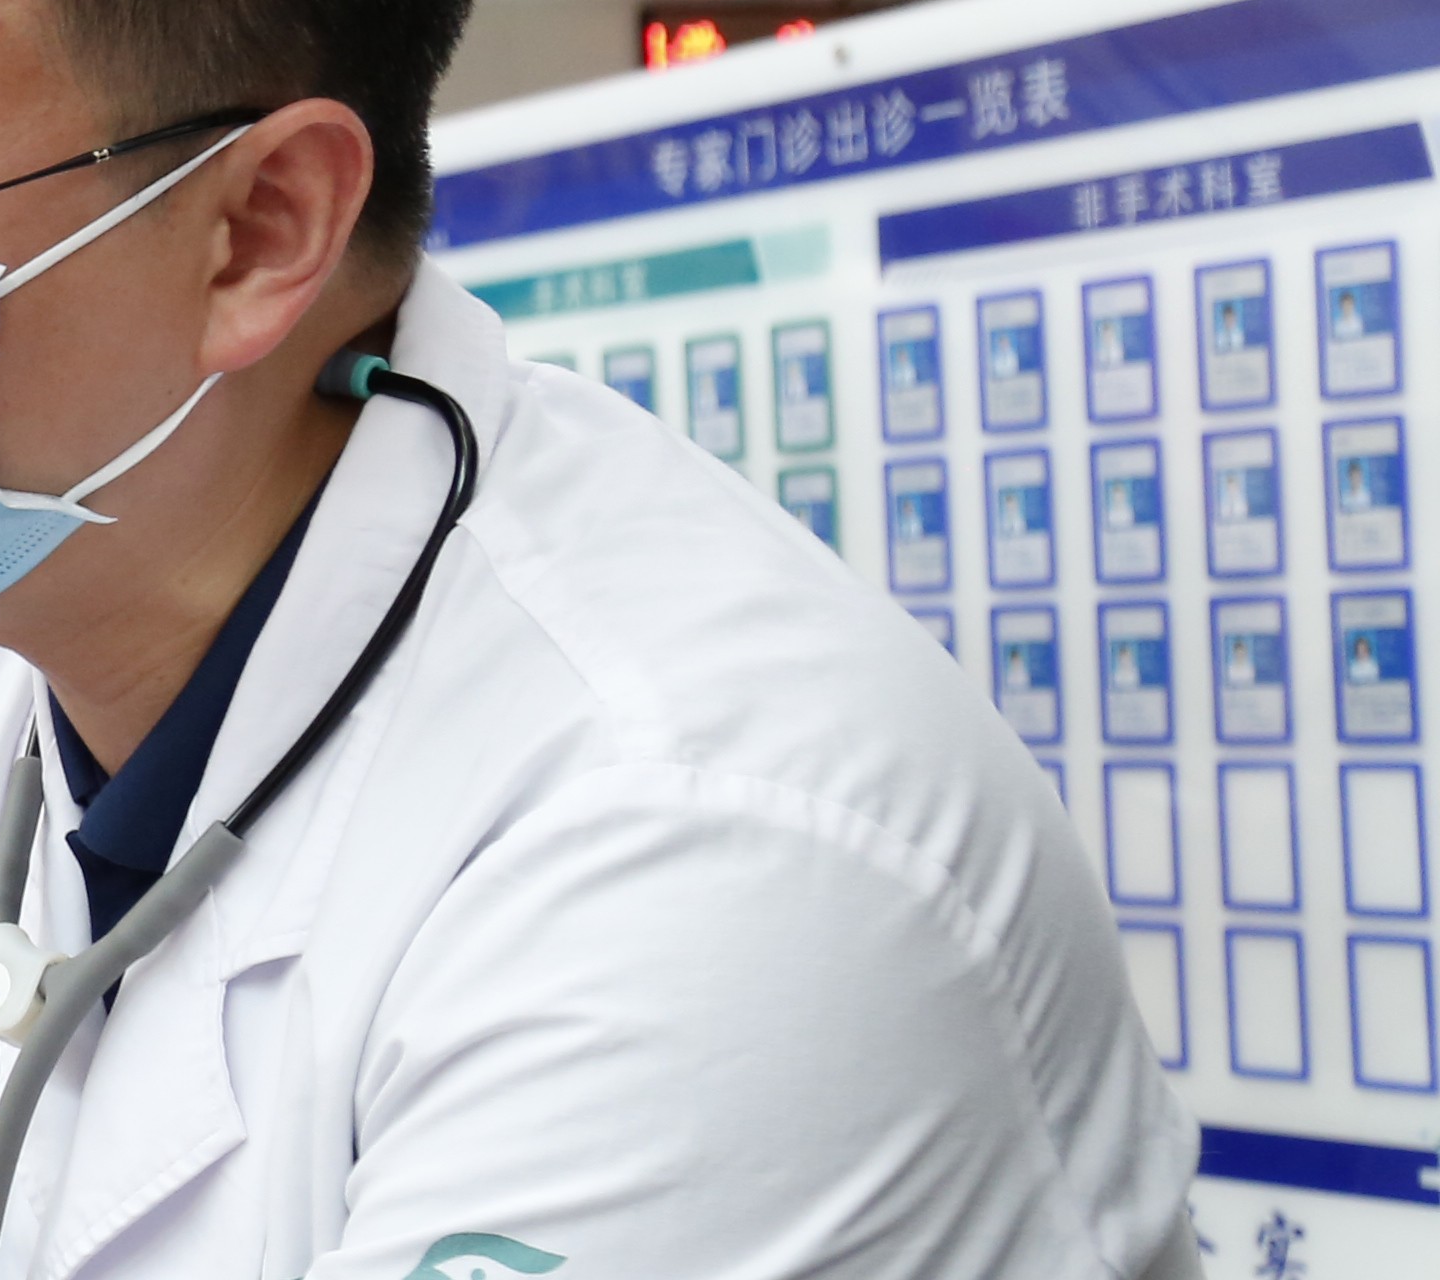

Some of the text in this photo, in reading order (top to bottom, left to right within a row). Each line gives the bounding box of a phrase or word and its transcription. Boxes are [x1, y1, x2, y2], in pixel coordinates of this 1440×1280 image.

[650, 56, 1071, 199] 专家门诊出诊一览表
[1071, 154, 1282, 230] 非手术科室
